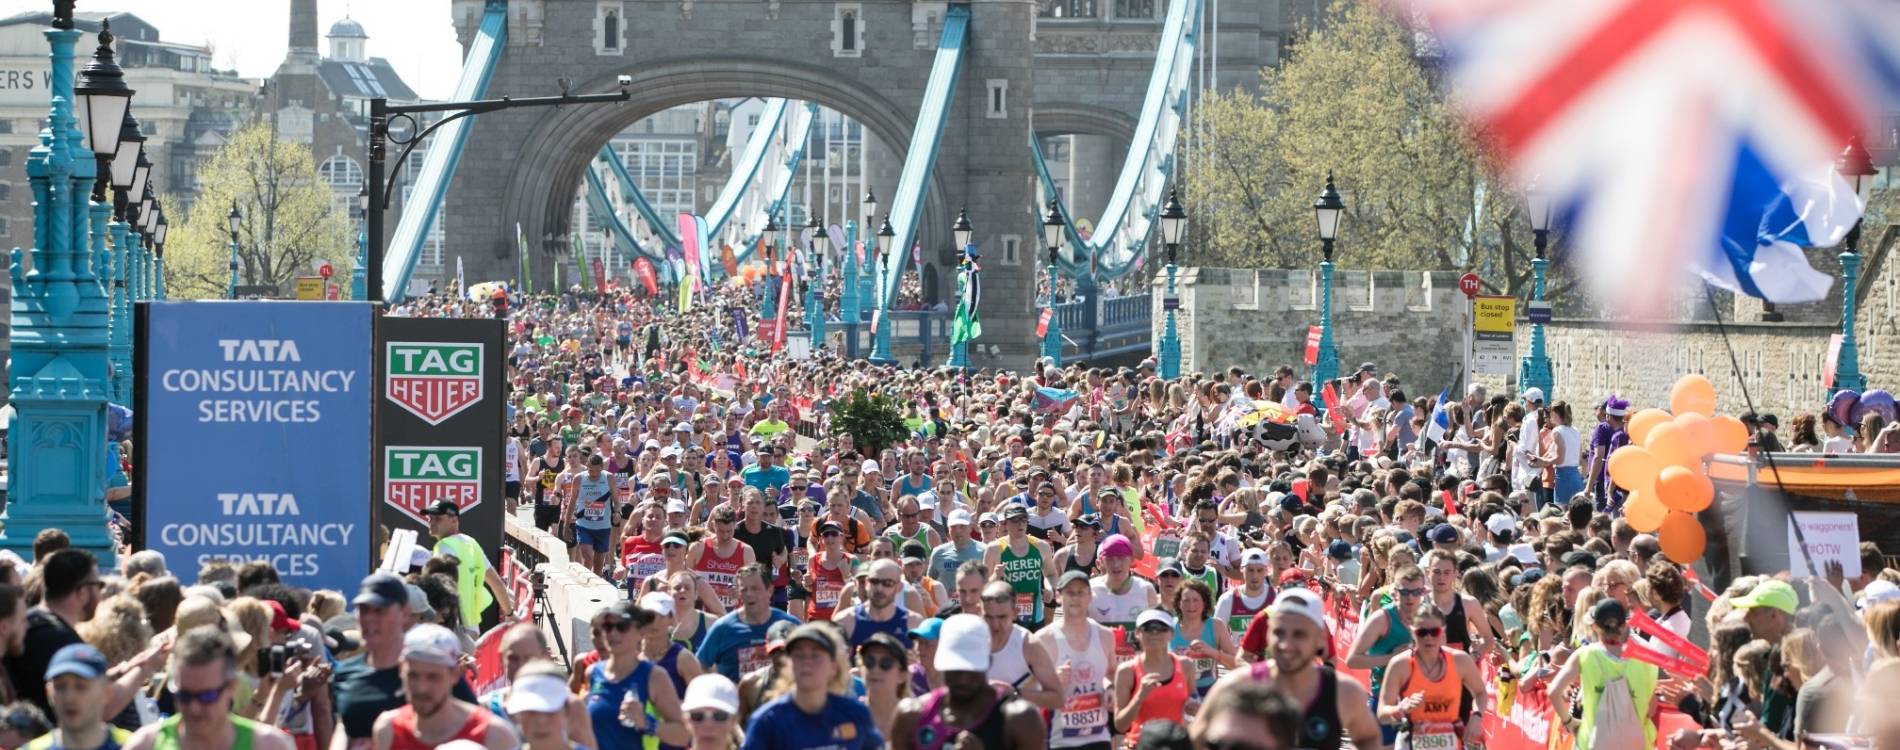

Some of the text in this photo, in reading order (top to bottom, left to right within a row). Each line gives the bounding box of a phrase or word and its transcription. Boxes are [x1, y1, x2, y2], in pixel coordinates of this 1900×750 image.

[1463, 279, 1478, 289] TH
[1495, 303, 1510, 312] stop
[218, 339, 301, 362] TATA
[395, 349, 474, 373] TAG
[162, 369, 356, 392] CONSULTANCY
[393, 380, 476, 418] HEUER
[198, 399, 321, 423] SERVICES
[393, 453, 473, 477] TAG
[217, 493, 300, 516] TATA
[160, 523, 354, 546] CONSULTANCY
[706, 560, 737, 570] Shelter
[708, 573, 734, 584] MARK
[1063, 709, 1100, 726] 18837
[1424, 701, 1450, 713] AMY
[1413, 734, 1454, 749] 28961
